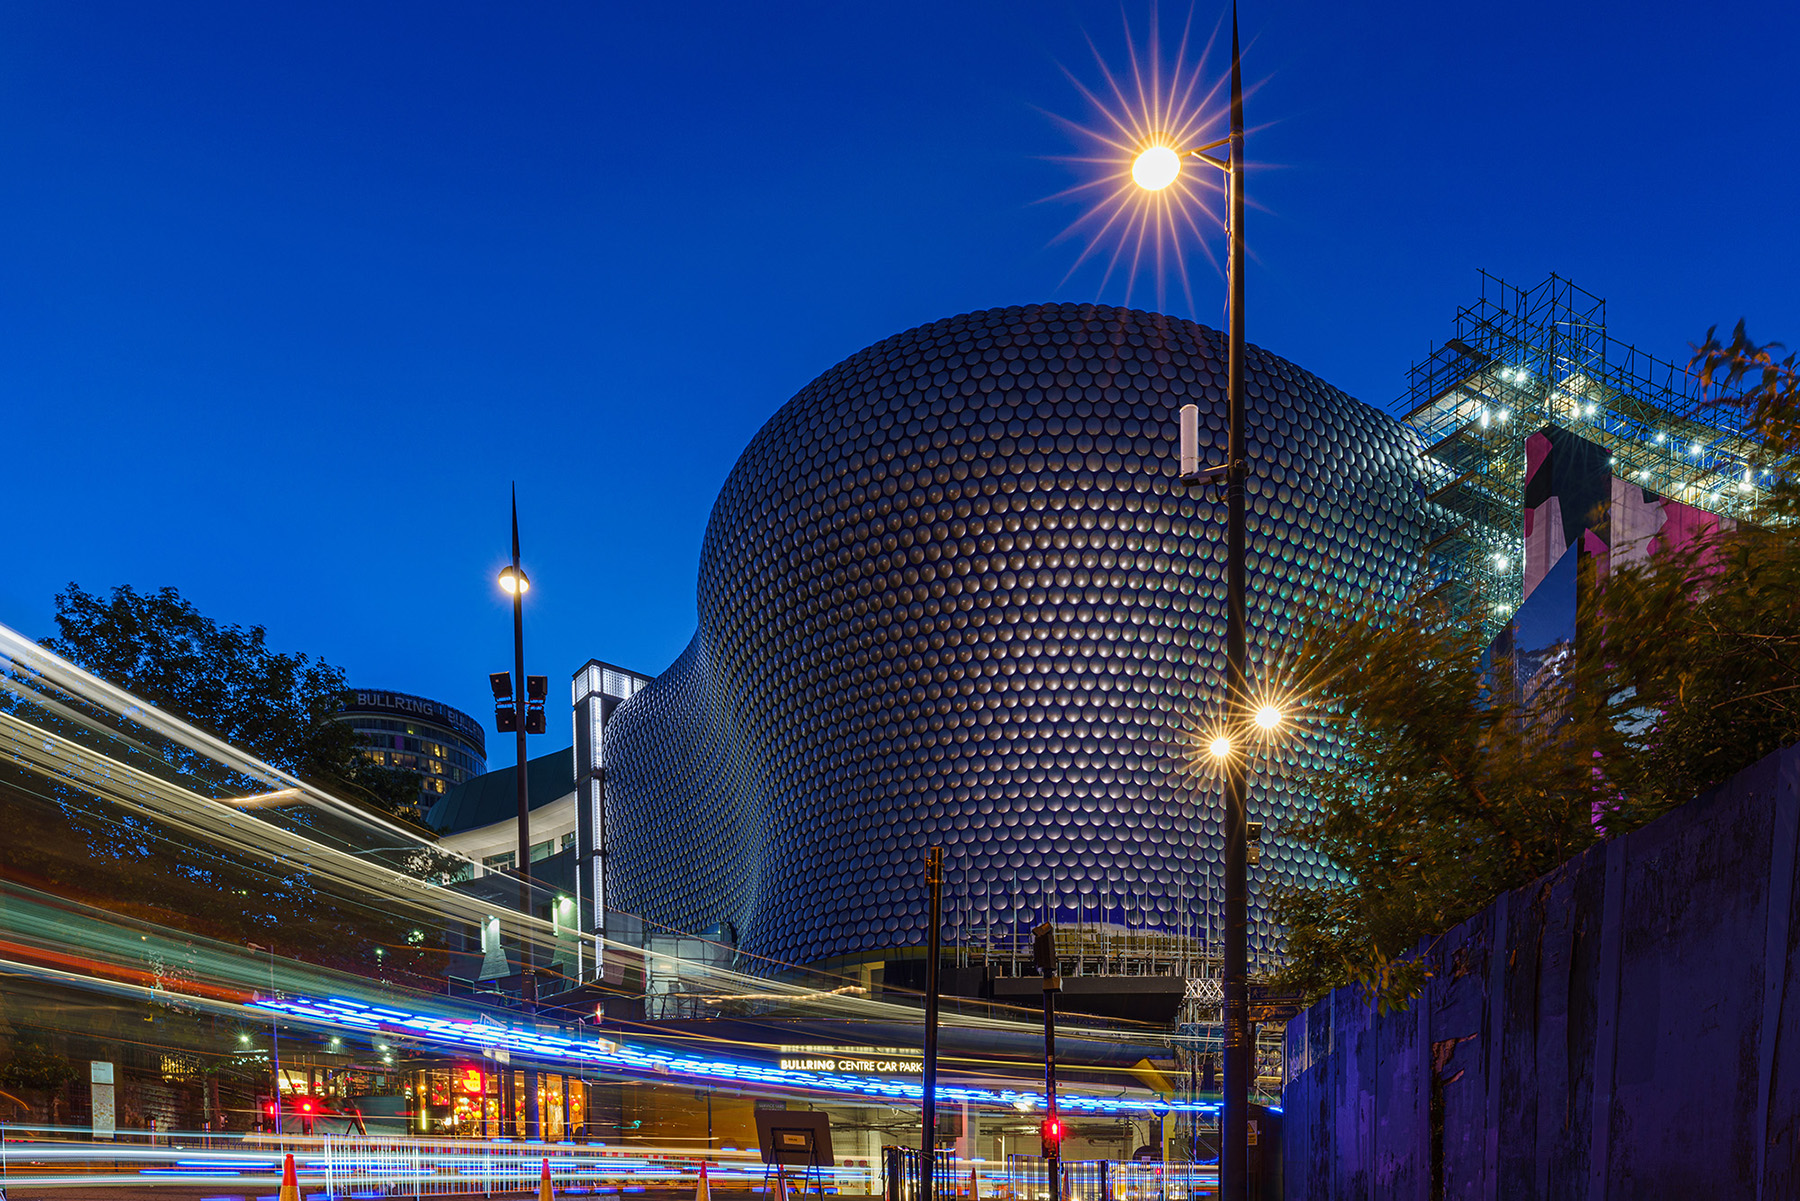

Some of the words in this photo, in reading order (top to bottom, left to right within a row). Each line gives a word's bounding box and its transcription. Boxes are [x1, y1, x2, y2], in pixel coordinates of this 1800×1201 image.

[357, 693, 434, 716] BULLRING
[780, 1059, 836, 1070] BULLRING
[837, 1060, 876, 1071] CENTRE
[876, 1061, 898, 1072] CAR
[899, 1061, 923, 1073] PARK
